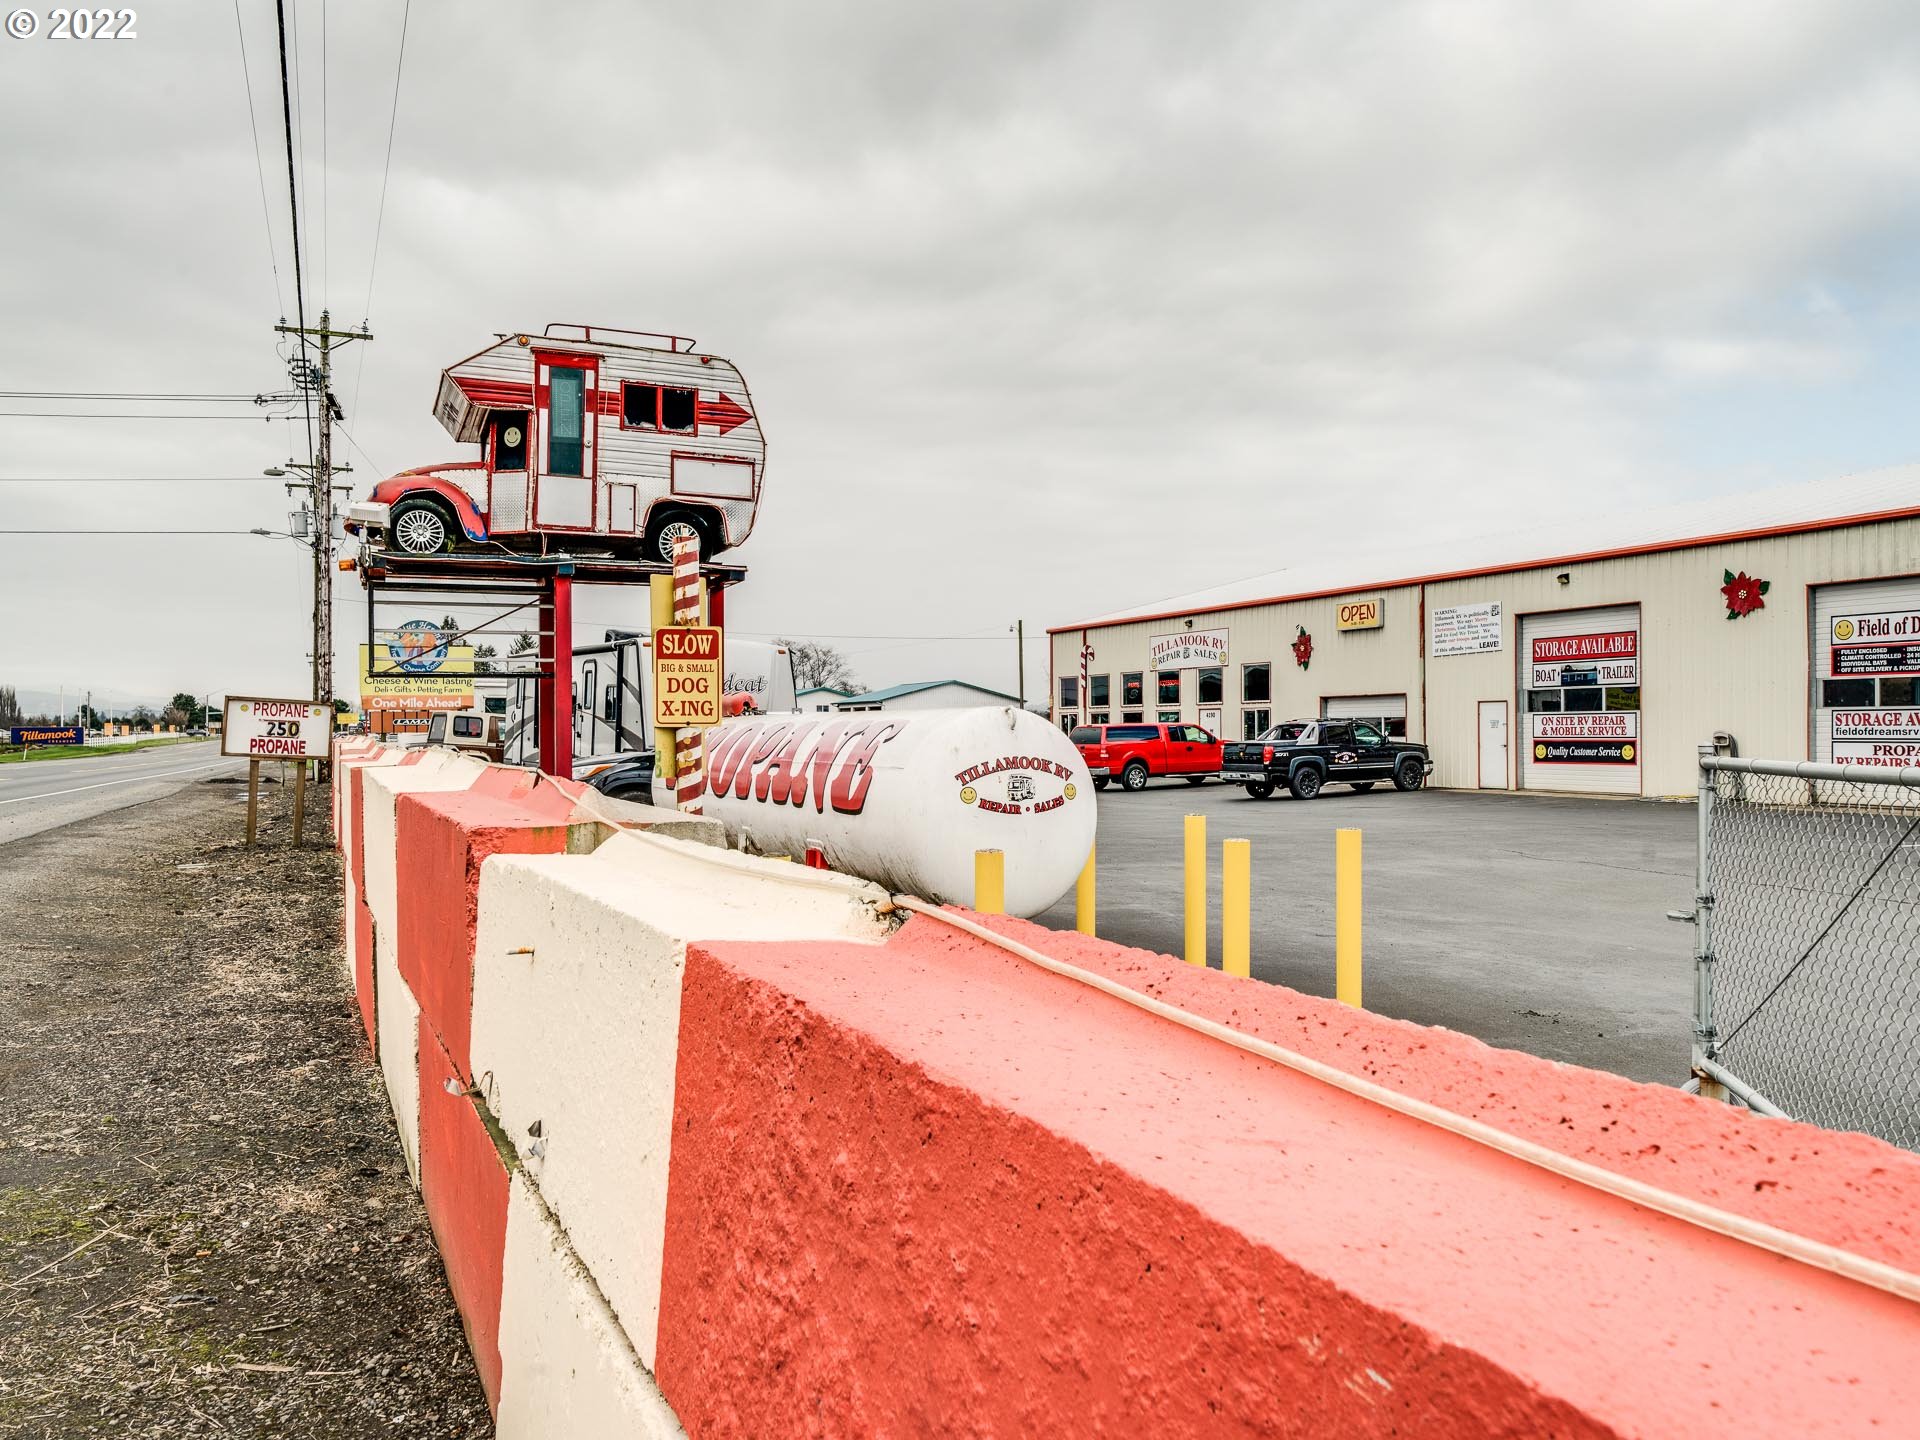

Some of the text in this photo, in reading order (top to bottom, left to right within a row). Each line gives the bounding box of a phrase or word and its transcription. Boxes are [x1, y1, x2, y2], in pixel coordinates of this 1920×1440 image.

[1341, 603, 1376, 622] OPEN
[1857, 617, 1890, 637] Field
[1894, 616, 1909, 635] of
[662, 633, 713, 655] SLOW
[1152, 635, 1226, 657] TILLAMOOK RV
[1535, 635, 1634, 658] STORAGE AVAILABLE
[1158, 648, 1218, 665] REPAIR SALES
[660, 663, 714, 673] BIG & SMALL
[1535, 665, 1635, 682] BOAT TRAILER
[364, 676, 472, 687] Cheese & Wine Tasting
[374, 685, 463, 695] Deli Gifts Petting Farm
[667, 677, 709, 694] DOG
[253, 702, 310, 719] PROPANE
[371, 696, 462, 709] One Mile Ahead
[661, 700, 714, 717] X-ING
[1541, 715, 1626, 726] ON SITE RV REPAIR
[1835, 712, 1903, 727] STORAGE
[20, 728, 77, 741] Tillamook
[266, 721, 301, 737] 250
[1541, 726, 1627, 736] & MOBILE SERVICE
[1835, 727, 1920, 736] fieldofdreamsrv
[249, 738, 307, 755] PROPANE
[1547, 746, 1621, 758] Quality Customer Service
[954, 755, 1074, 787] TILLAMOOK RV
[1856, 757, 1911, 768] REPAIRS
[977, 795, 1065, 815] REPAIR SALES
